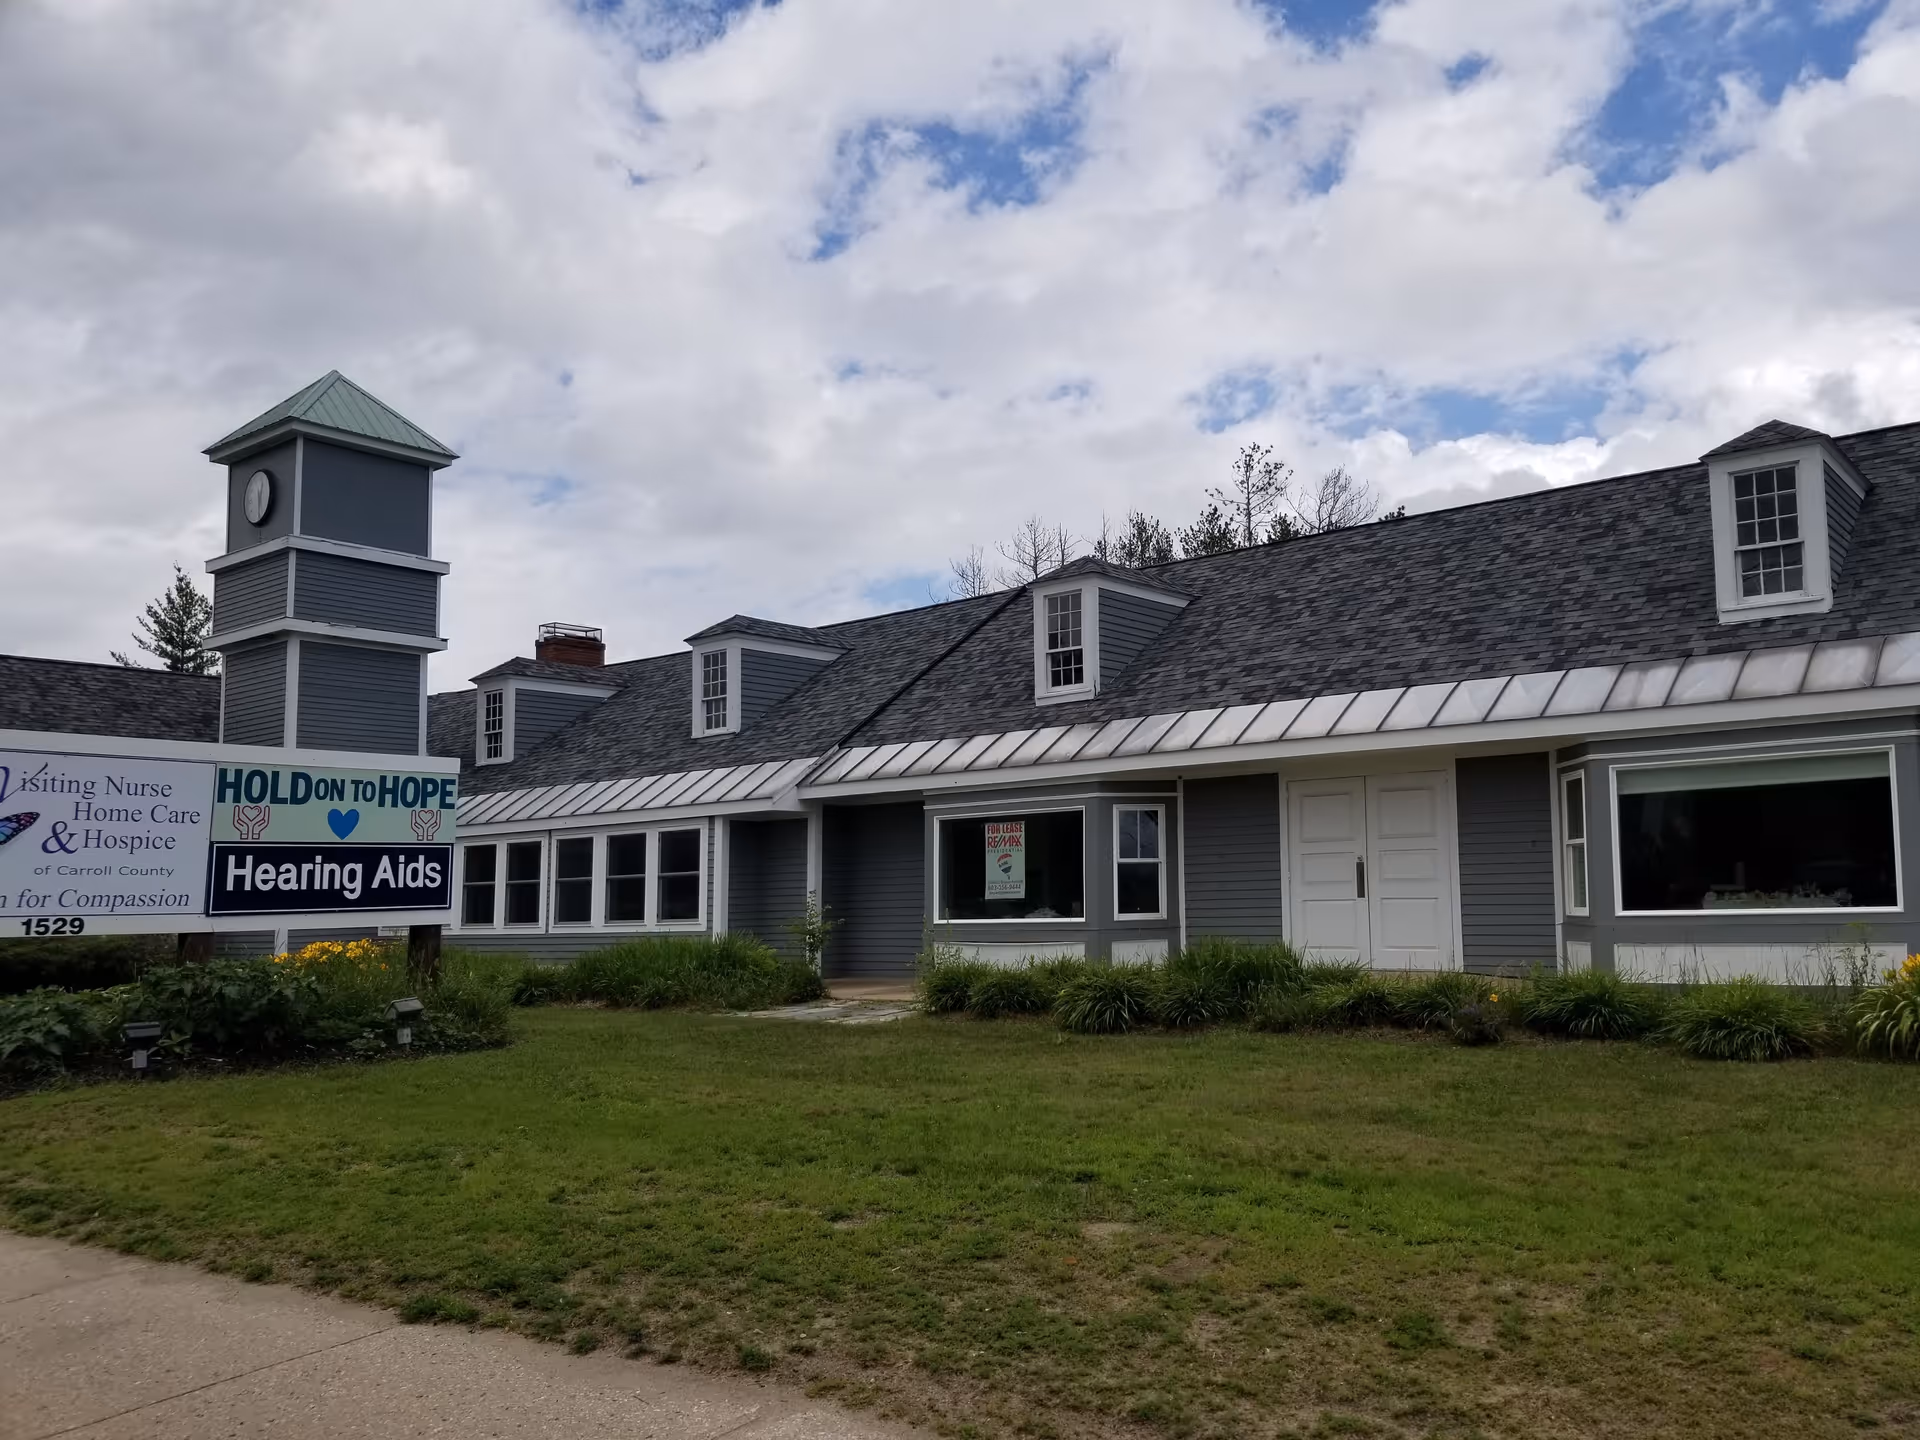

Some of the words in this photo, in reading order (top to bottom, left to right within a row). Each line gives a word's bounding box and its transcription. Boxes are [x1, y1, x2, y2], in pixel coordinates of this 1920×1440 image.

[105, 776, 172, 798] Nurse
[217, 767, 313, 805] HOLD
[314, 778, 346, 802] ON
[350, 779, 377, 803] TO
[377, 774, 457, 810] HOPE
[72, 801, 142, 822] Home
[151, 804, 200, 824] Care
[41, 820, 78, 854] &
[83, 829, 176, 854] Hospice
[987, 824, 1001, 835] FOR
[1002, 822, 1023, 834] LEASE
[987, 835, 1023, 849] RE/MAX
[34, 865, 51, 876] of
[57, 865, 112, 876] Carroll
[119, 866, 175, 877] County
[226, 854, 363, 899] Hearing
[371, 854, 442, 889] Aids
[16, 888, 51, 908] for
[58, 888, 190, 912] Compassion
[20, 917, 85, 936] 1529
